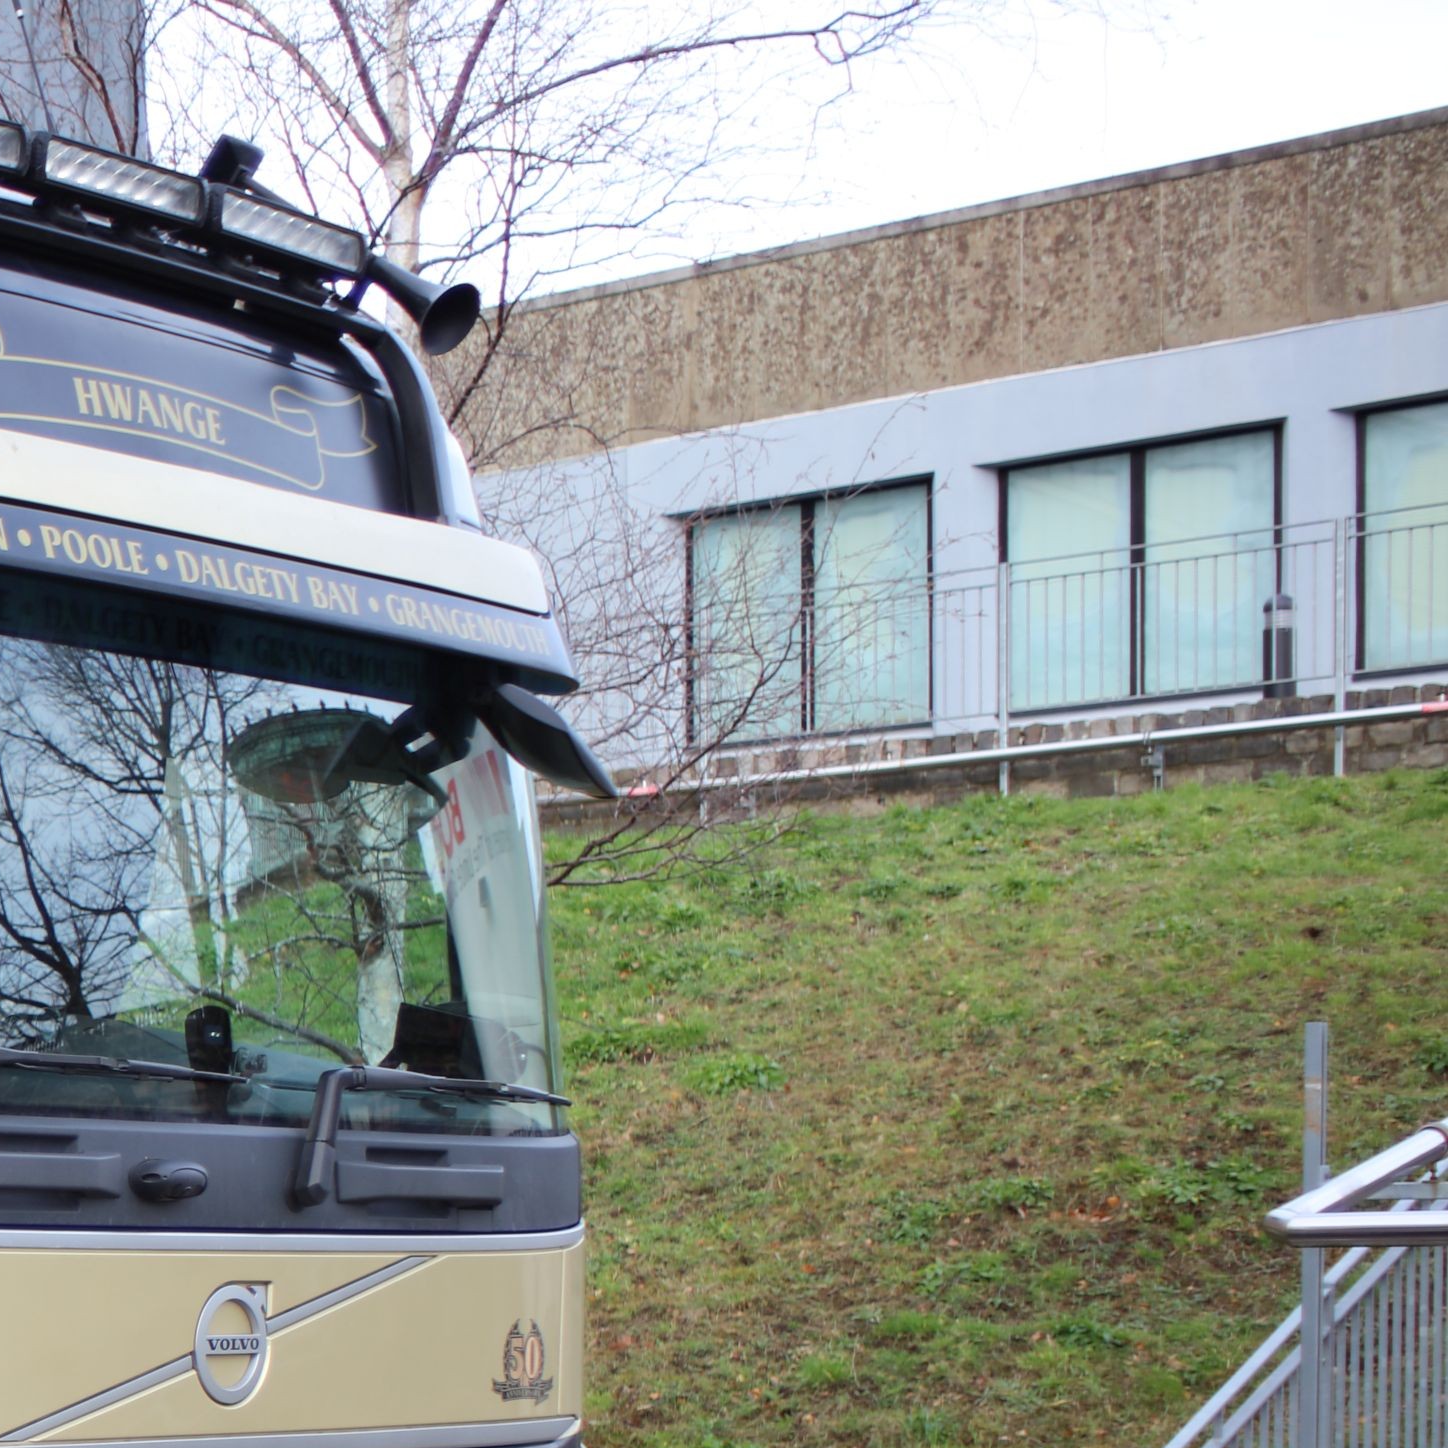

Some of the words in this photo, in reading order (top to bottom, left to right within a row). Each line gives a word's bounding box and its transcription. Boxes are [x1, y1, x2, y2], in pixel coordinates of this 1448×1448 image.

[73, 376, 226, 445] HWANGE
[39, 525, 148, 575] POOLE
[176, 550, 301, 603] DALGETY
[308, 577, 359, 615] BAY
[385, 594, 551, 656] GRANGEMOUTH
[207, 1338, 259, 1350] VOLVO
[509, 1335, 544, 1380] 50
